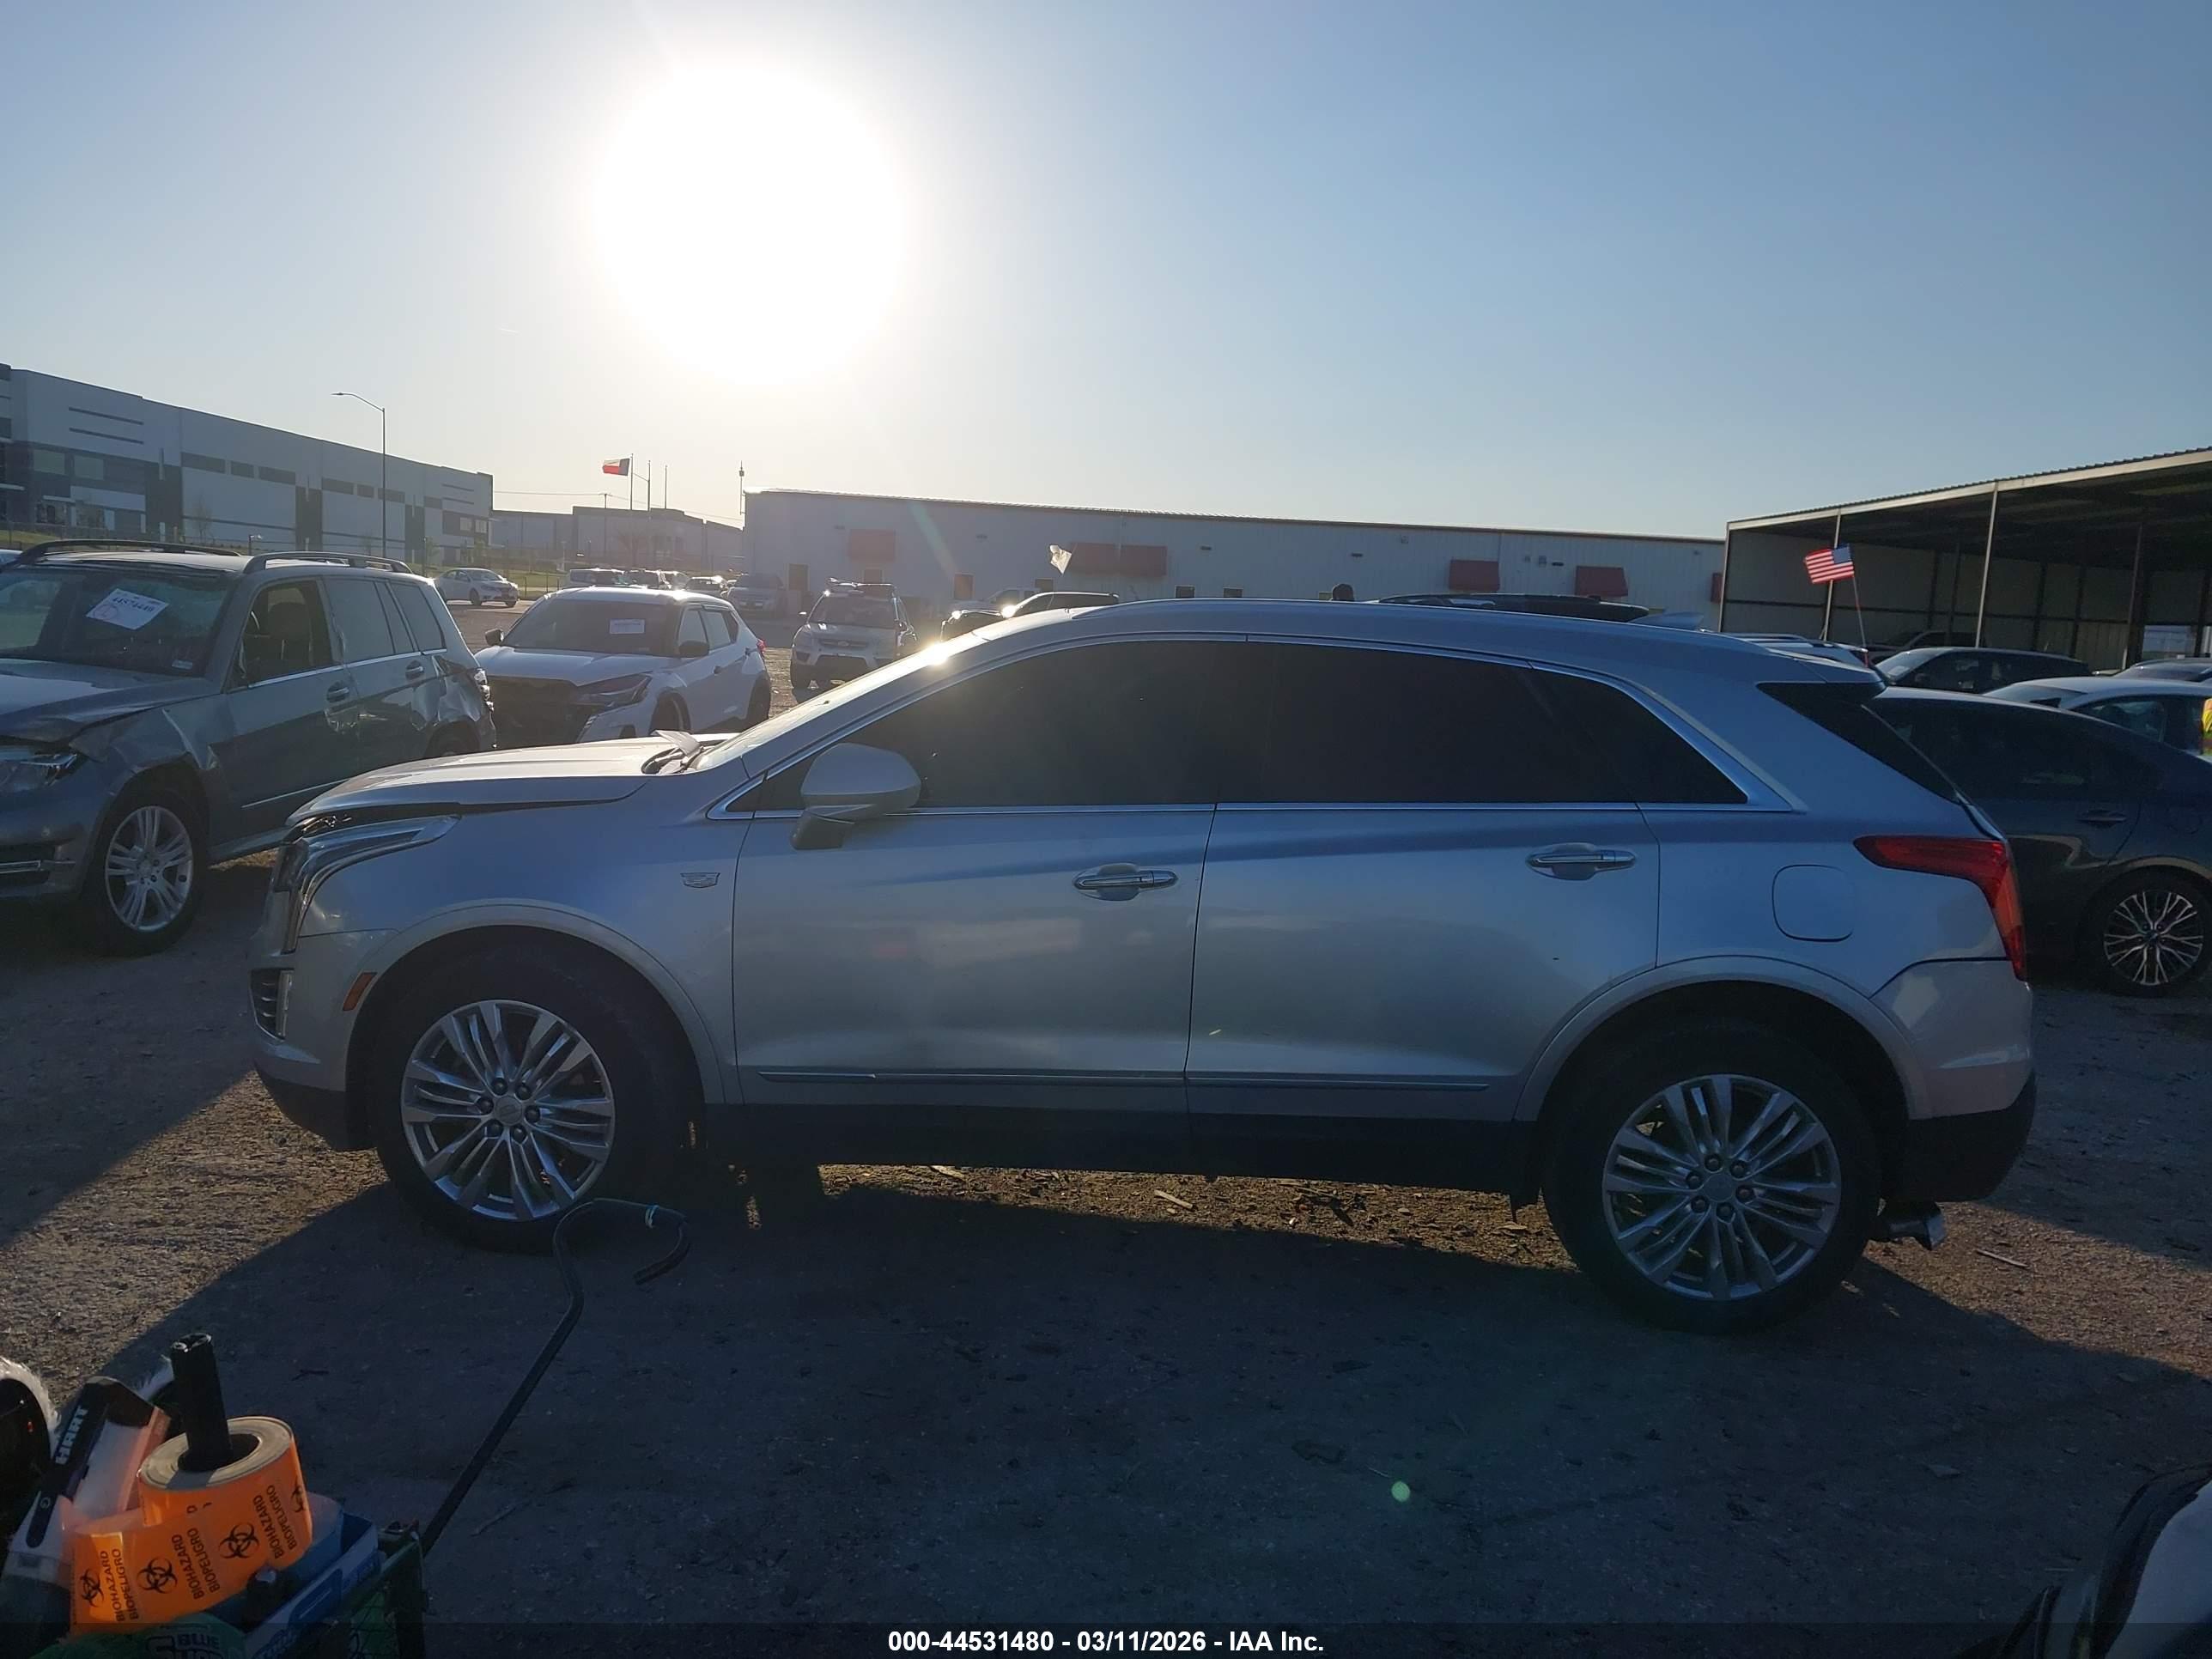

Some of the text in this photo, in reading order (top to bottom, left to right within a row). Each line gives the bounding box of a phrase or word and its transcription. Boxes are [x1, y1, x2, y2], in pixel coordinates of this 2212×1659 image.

[55, 1405, 88, 1465] HART
[252, 1494, 285, 1559] BIOHAZARD
[266, 1485, 297, 1551] BIOPELIGRO
[100, 1550, 126, 1622] BIOHAZARD
[112, 1548, 139, 1620] BIOPELIGRO
[171, 1534, 205, 1600] BIOHAZARD
[186, 1528, 221, 1593] BIOPELIGRO
